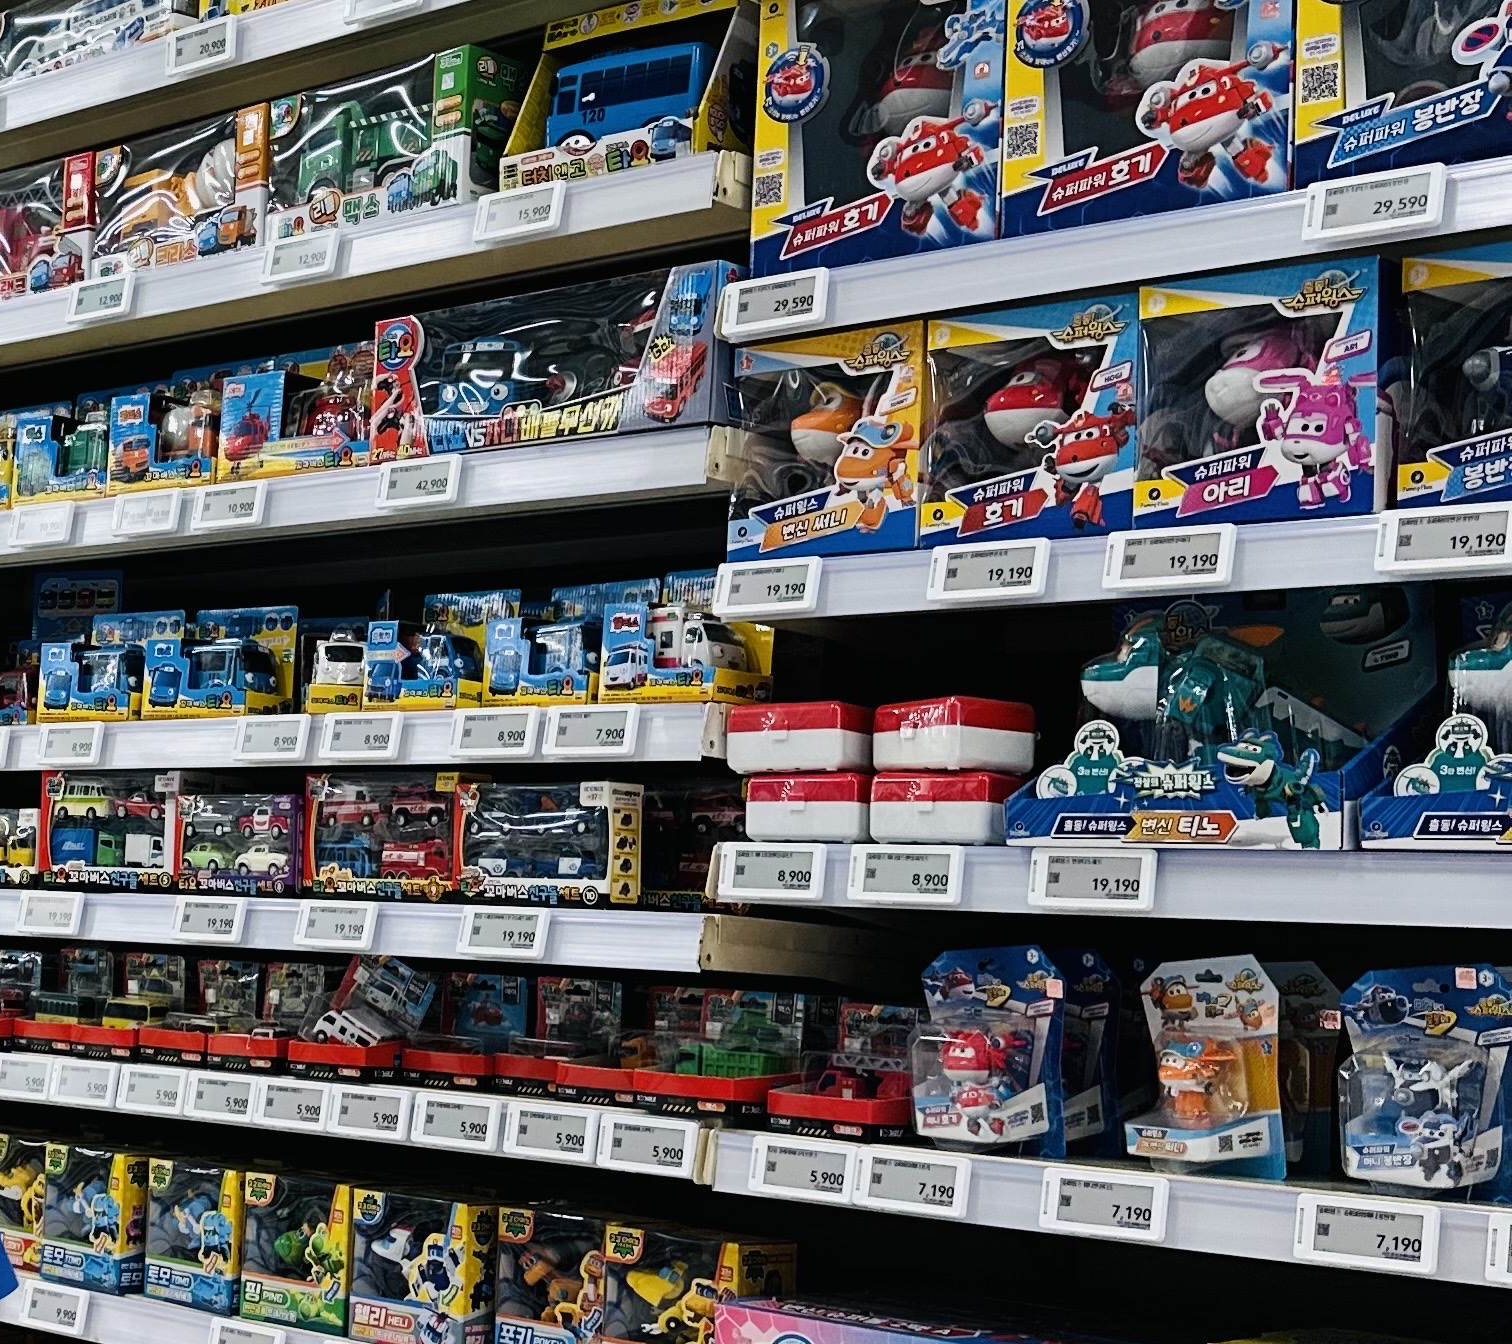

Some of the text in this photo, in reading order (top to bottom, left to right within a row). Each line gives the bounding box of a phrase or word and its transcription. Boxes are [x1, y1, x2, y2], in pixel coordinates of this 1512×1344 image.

[199, 38, 226, 55] 20,900
[581, 108, 604, 124] 120
[1342, 106, 1380, 125] DELUXE
[1342, 89, 1484, 152] 슈퍼파워 봉반장
[607, 140, 650, 172] 타요
[522, 162, 587, 186] 터치앤고
[1051, 159, 1085, 176] DELUXE
[1051, 153, 1152, 202] 슈퍼파워 호기
[343, 194, 381, 224] 맥스
[518, 203, 551, 221] 15,900
[1373, 192, 1428, 217] 29,590
[792, 202, 880, 247] 슈퍼파워 호기
[298, 249, 326, 265] 12,900
[98, 292, 123, 308] 12,900
[774, 295, 814, 313] 29,590
[1280, 287, 1367, 311] 슈퍼윙스
[1053, 319, 1126, 343] 슈퍼윙스
[378, 337, 416, 362] 타요
[845, 349, 911, 371] 슈퍼윙스
[465, 421, 485, 448] VS
[1194, 455, 1252, 481] 슈퍼파워
[416, 478, 448, 493] 42,900
[973, 477, 1024, 501] 슈퍼파워
[1201, 476, 1251, 504] 아리
[227, 502, 254, 515] 10,900
[774, 497, 820, 520] 슈퍼윙스
[984, 494, 1022, 526] 호기
[781, 508, 848, 541] 변신 써니
[1450, 533, 1506, 553] 19,190
[1169, 553, 1218, 571] 19,190
[987, 566, 1033, 584] 19,190
[766, 582, 806, 599] 19,190
[273, 736, 297, 747] 8,900
[364, 734, 390, 746] 8,900
[497, 729, 525, 743] 8,900
[595, 728, 625, 742] 7,900
[1161, 770, 1215, 791] 슈퍼윙스
[1087, 814, 1220, 838] 슈퍼윙스 변신 티노
[1428, 816, 1503, 833] 출동! 슈퍼윙스
[777, 868, 812, 885] 8,900
[911, 871, 949, 889] 8,900
[1091, 877, 1140, 894] 19,190
[207, 917, 234, 931] 19,190
[334, 922, 364, 937] 19,190
[502, 929, 536, 945] 19,190
[226, 1096, 248, 1110] 5,900
[297, 1104, 320, 1118] 5,900
[373, 1111, 398, 1127] 5,900
[460, 1121, 487, 1136] 5,900
[555, 1131, 584, 1148] 5,900
[652, 1145, 683, 1161] 5,900
[809, 1170, 844, 1187] 5,900
[918, 1182, 955, 1199] 7,190
[1112, 1205, 1151, 1222] 7,190
[1376, 1235, 1422, 1254] 7,190
[148, 1265, 171, 1285] 토모
[245, 1280, 284, 1304] 핑 PING
[355, 1304, 408, 1328] 헬리 HELI
